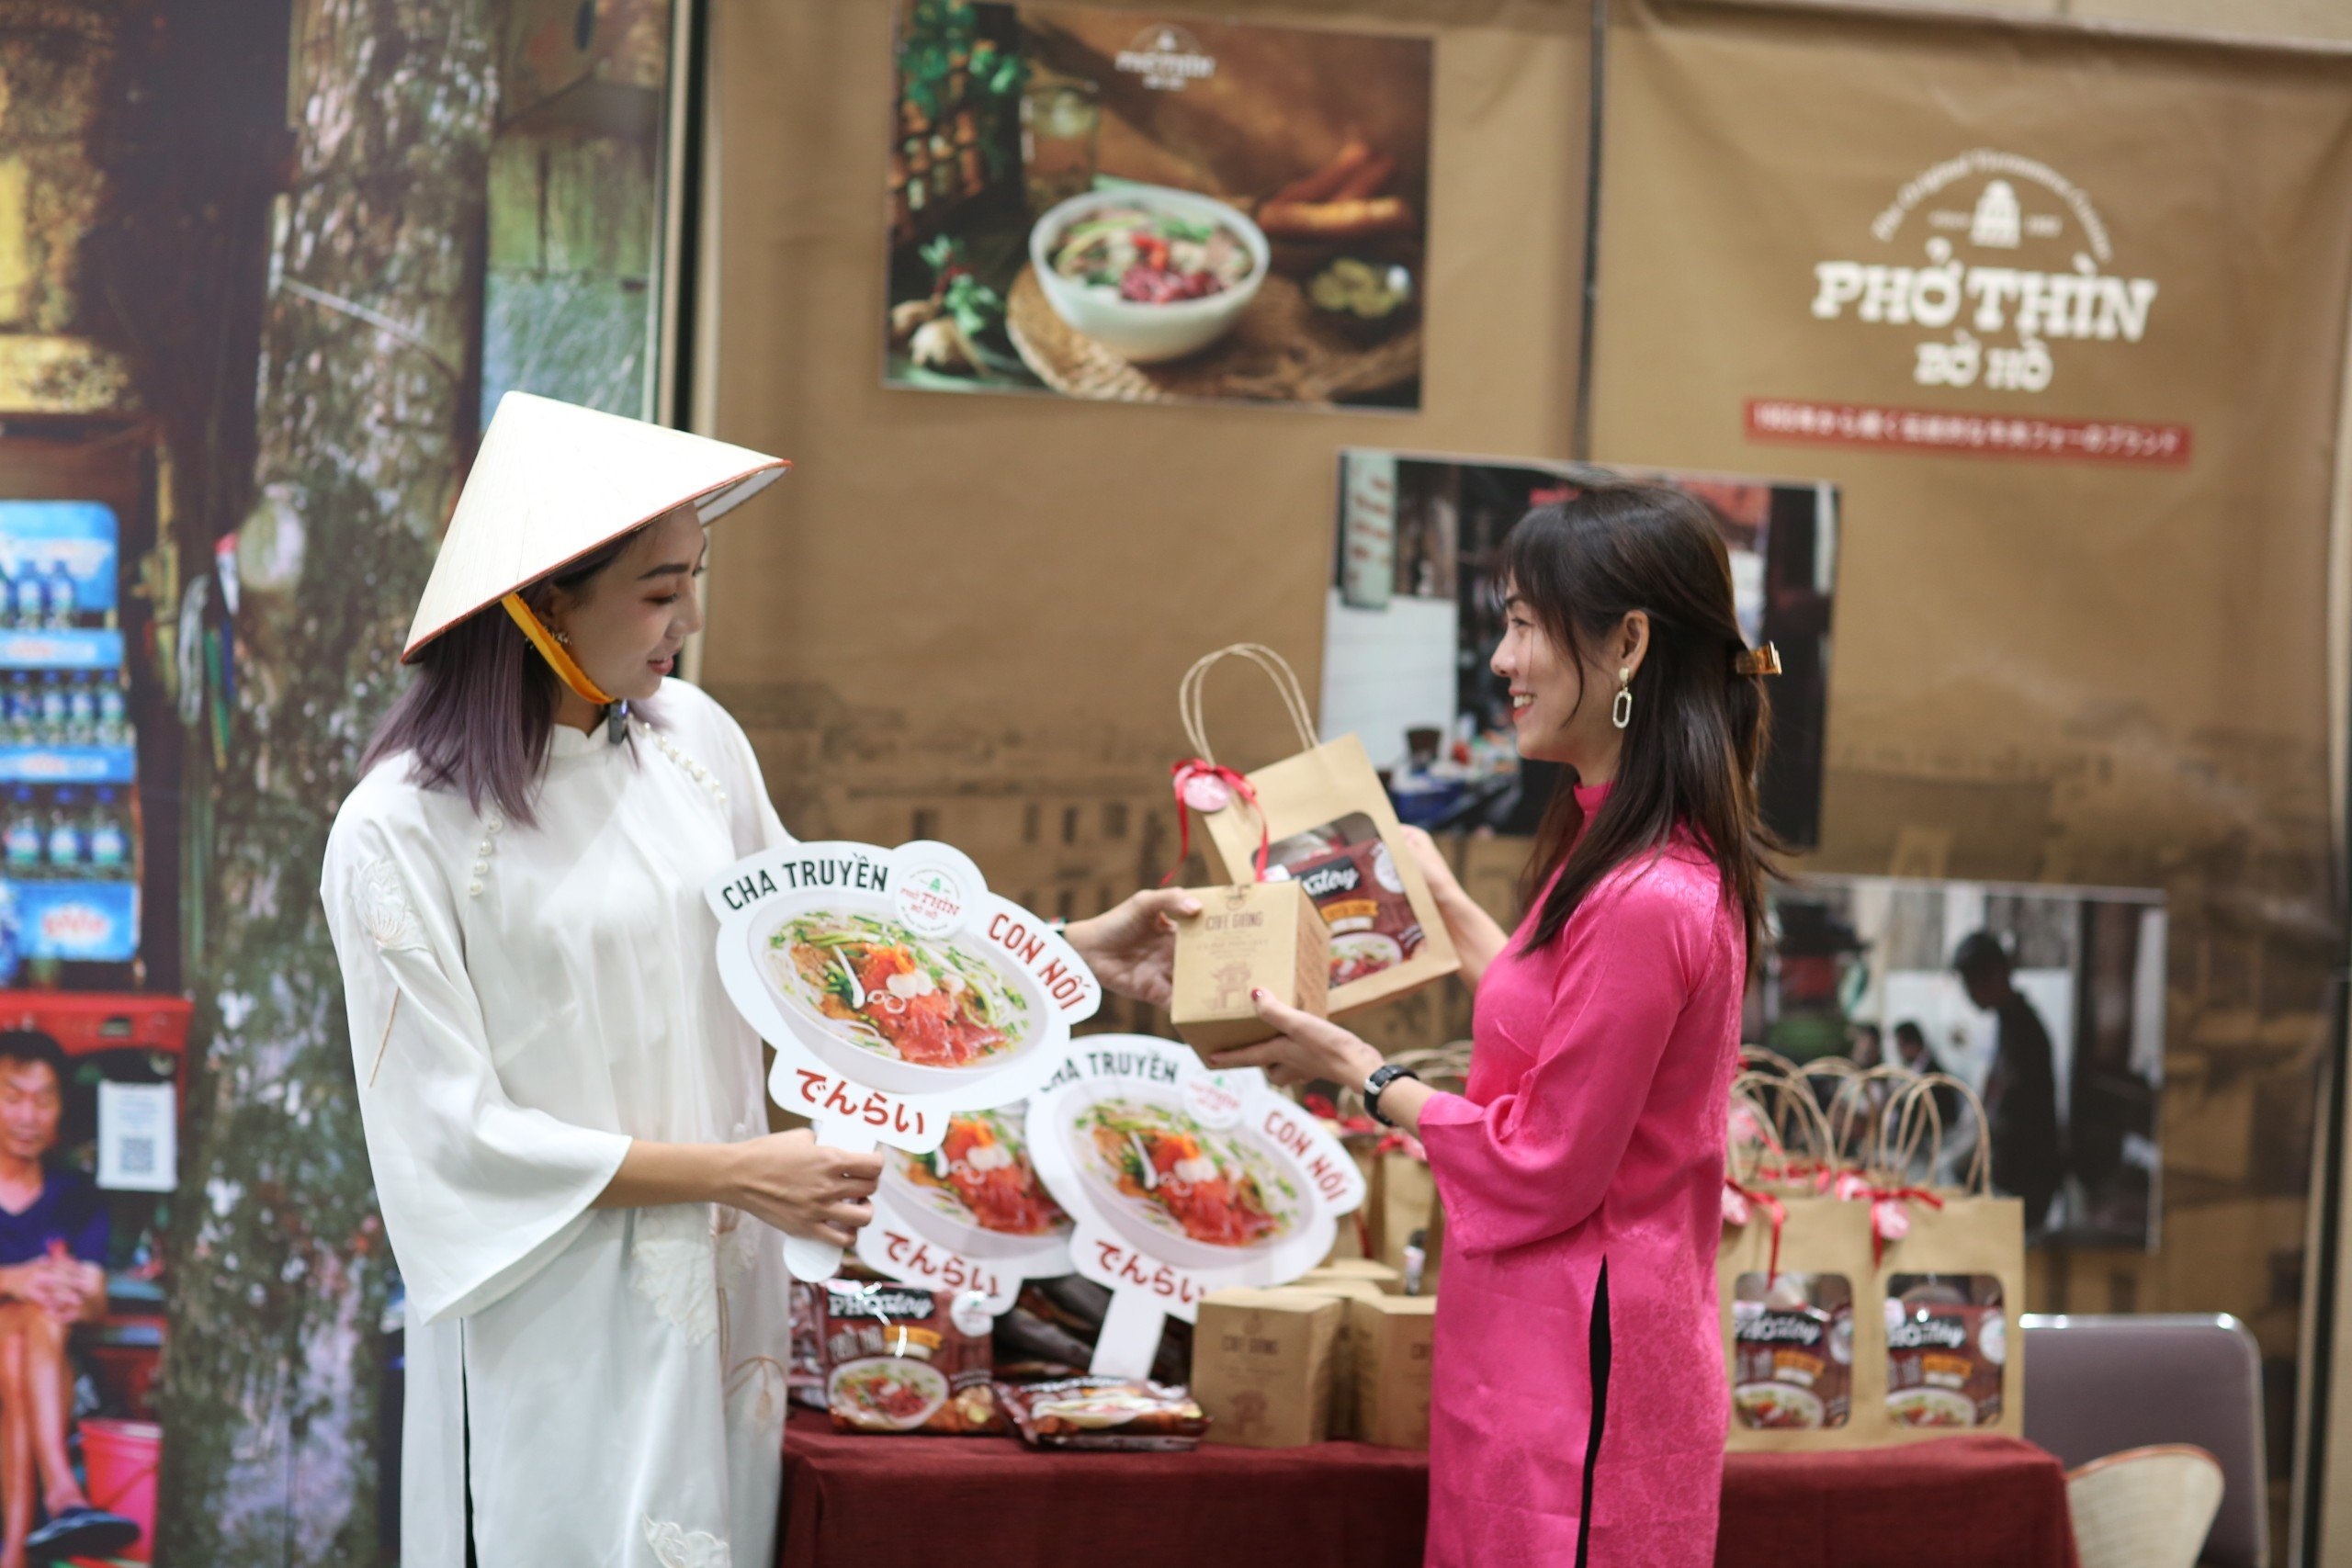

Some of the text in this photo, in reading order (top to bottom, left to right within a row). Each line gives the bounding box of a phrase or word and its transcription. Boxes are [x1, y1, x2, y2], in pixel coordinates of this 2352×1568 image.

[1812, 236, 2158, 343] PHỞ THÌN
[722, 869, 778, 910] CHA
[783, 852, 888, 892] TRUYỀN
[989, 914, 1045, 964] CON
[1037, 957, 1091, 1010] NỐI
[797, 1068, 925, 1135] でんらい
[1264, 1111, 1313, 1158] CON
[883, 1231, 1000, 1297] でんらい
